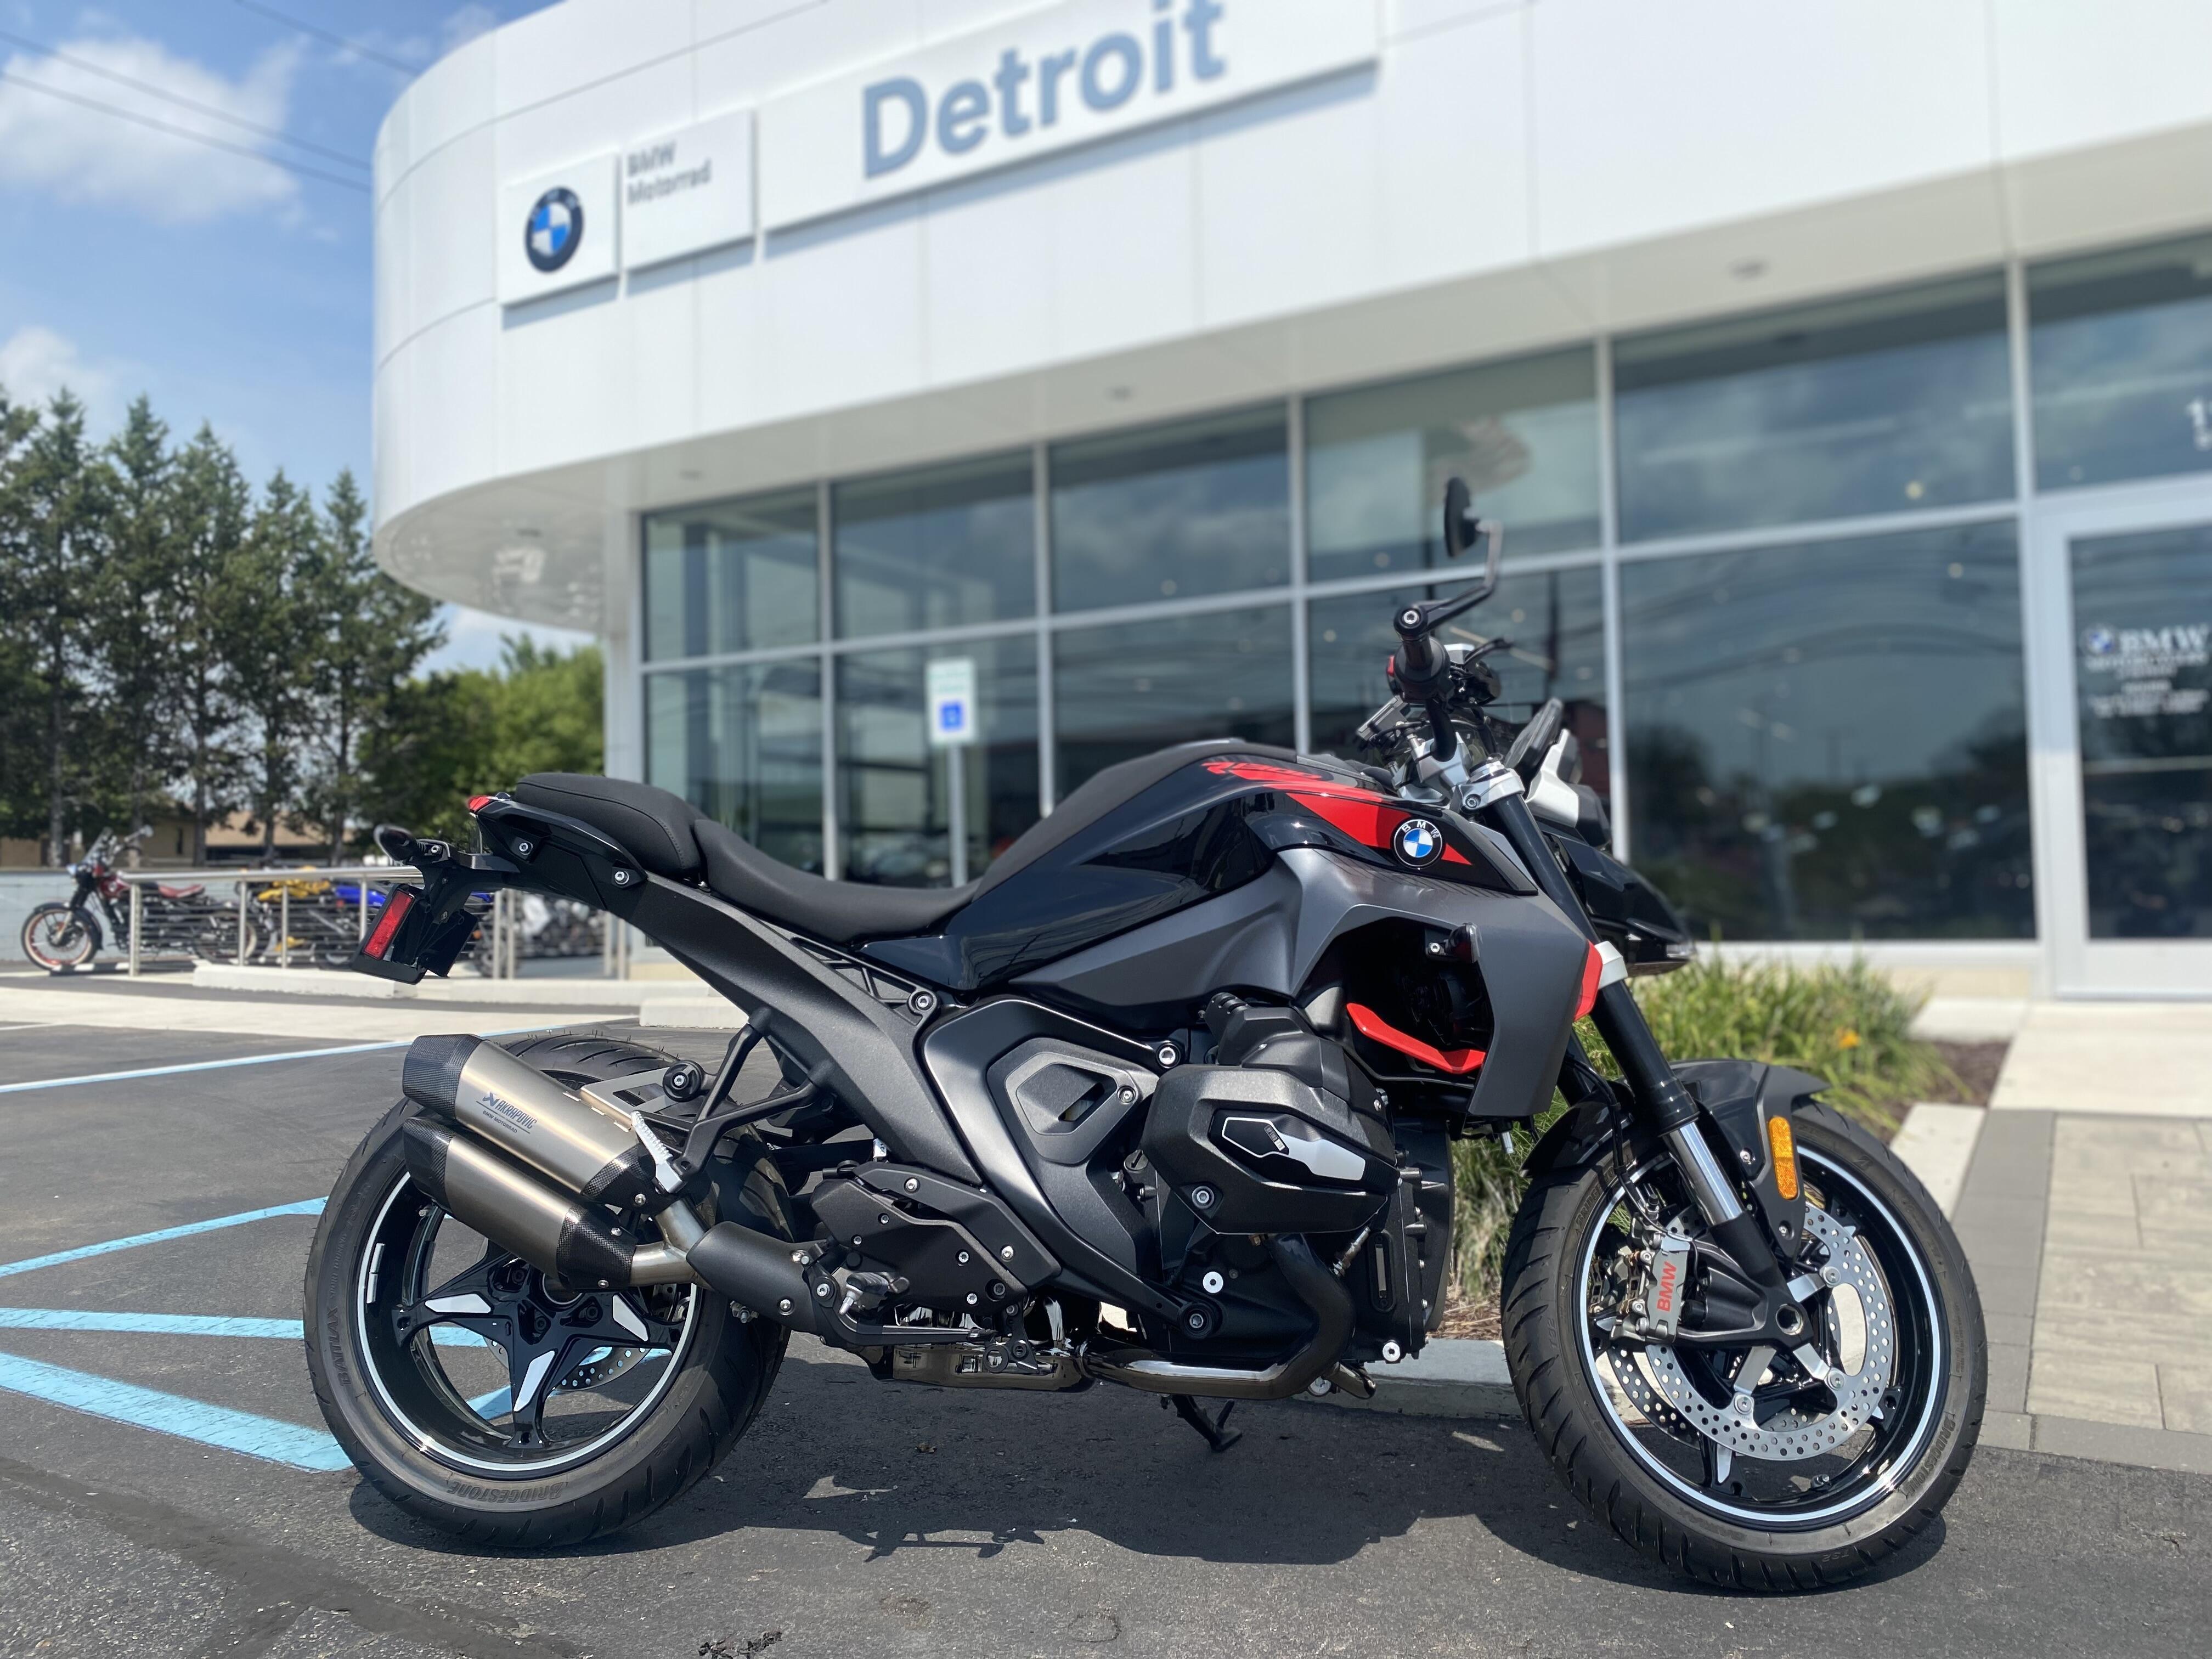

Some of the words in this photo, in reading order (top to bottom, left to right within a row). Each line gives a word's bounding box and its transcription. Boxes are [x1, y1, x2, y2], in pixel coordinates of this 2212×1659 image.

[862, 0, 1227, 180] Detroit
[627, 140, 676, 177] BMW
[627, 158, 712, 206] Motorrad
[1401, 820, 1441, 839] BMW
[482, 1110, 494, 1119] BMW
[493, 1118, 517, 1133] MOTORRAD
[1656, 1260, 1677, 1312] BMW
[447, 1481, 565, 1503] BRIDGESTONE
